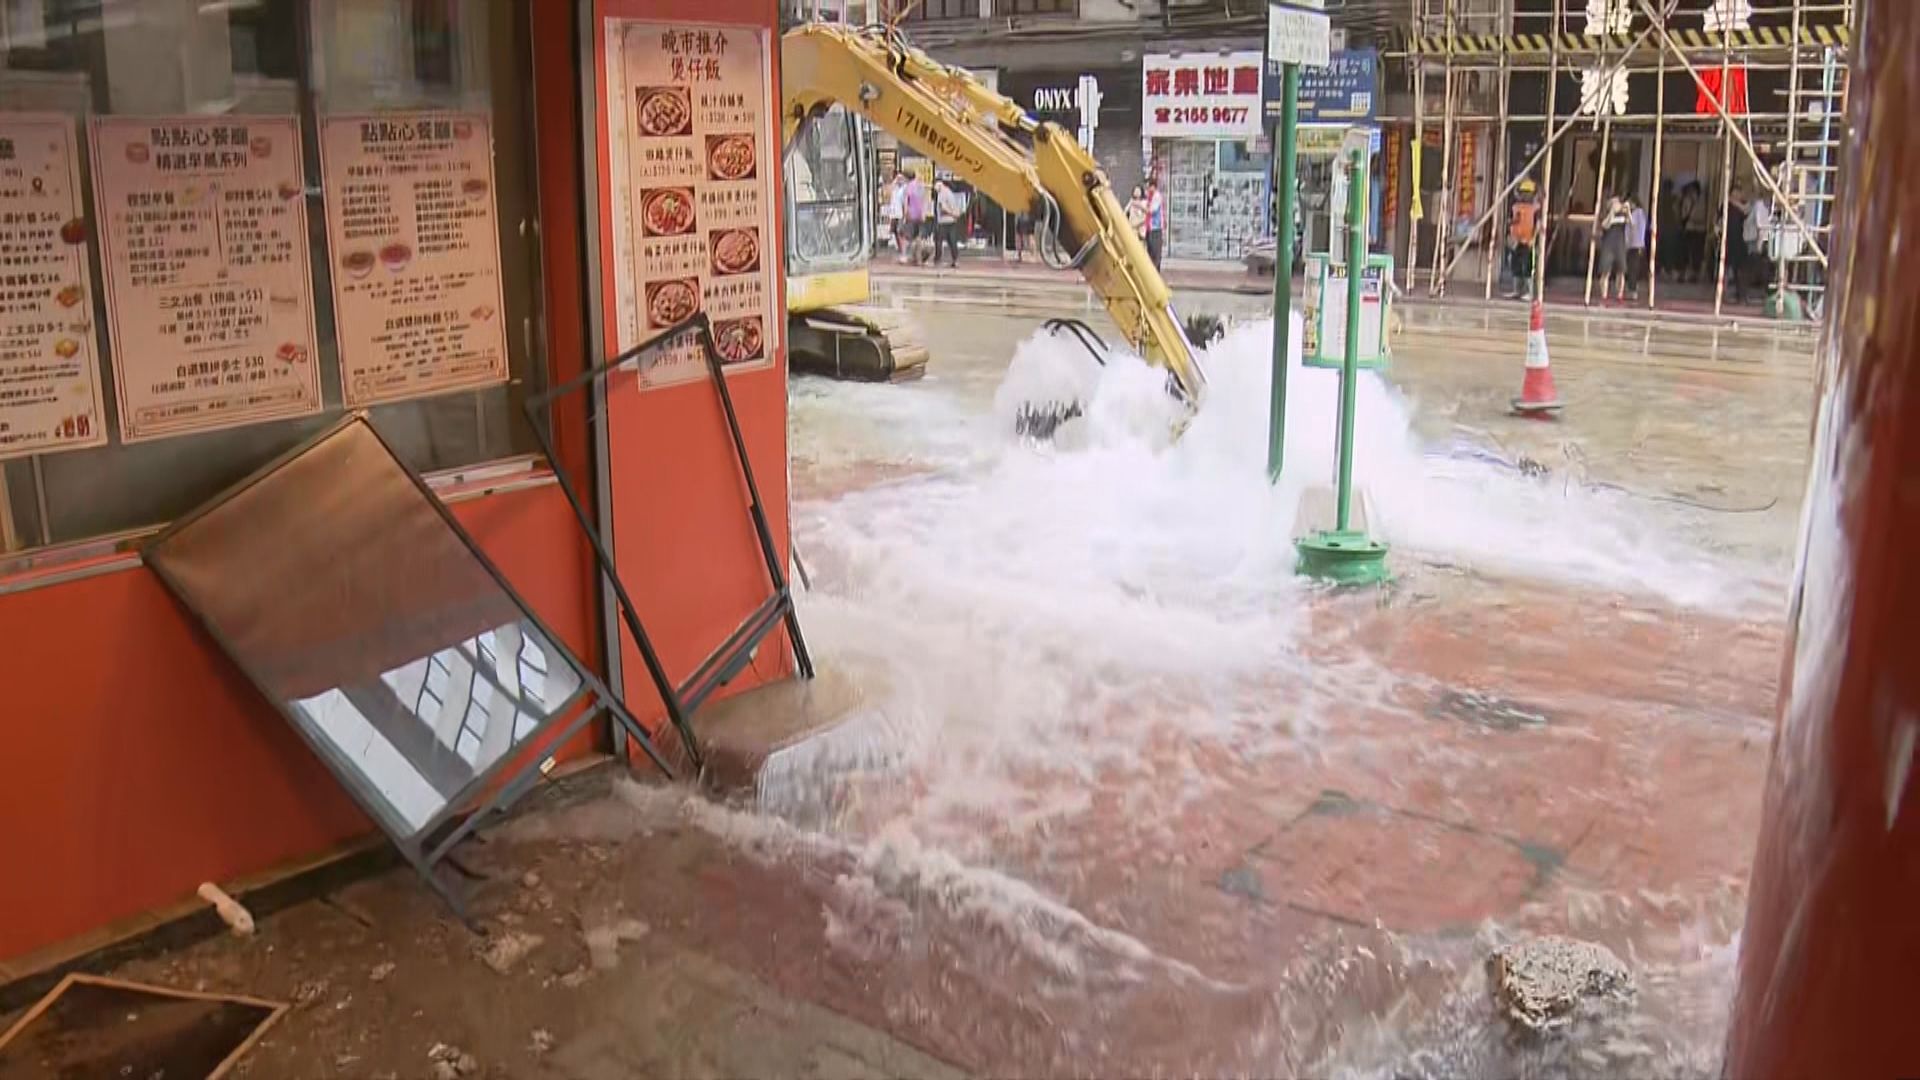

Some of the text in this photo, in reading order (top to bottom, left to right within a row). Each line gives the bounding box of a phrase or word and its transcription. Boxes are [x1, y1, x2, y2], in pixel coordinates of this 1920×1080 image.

[661, 29, 728, 56] 晚市推介
[671, 57, 722, 82] 煲仔飯
[1034, 87, 1071, 110] ONYX
